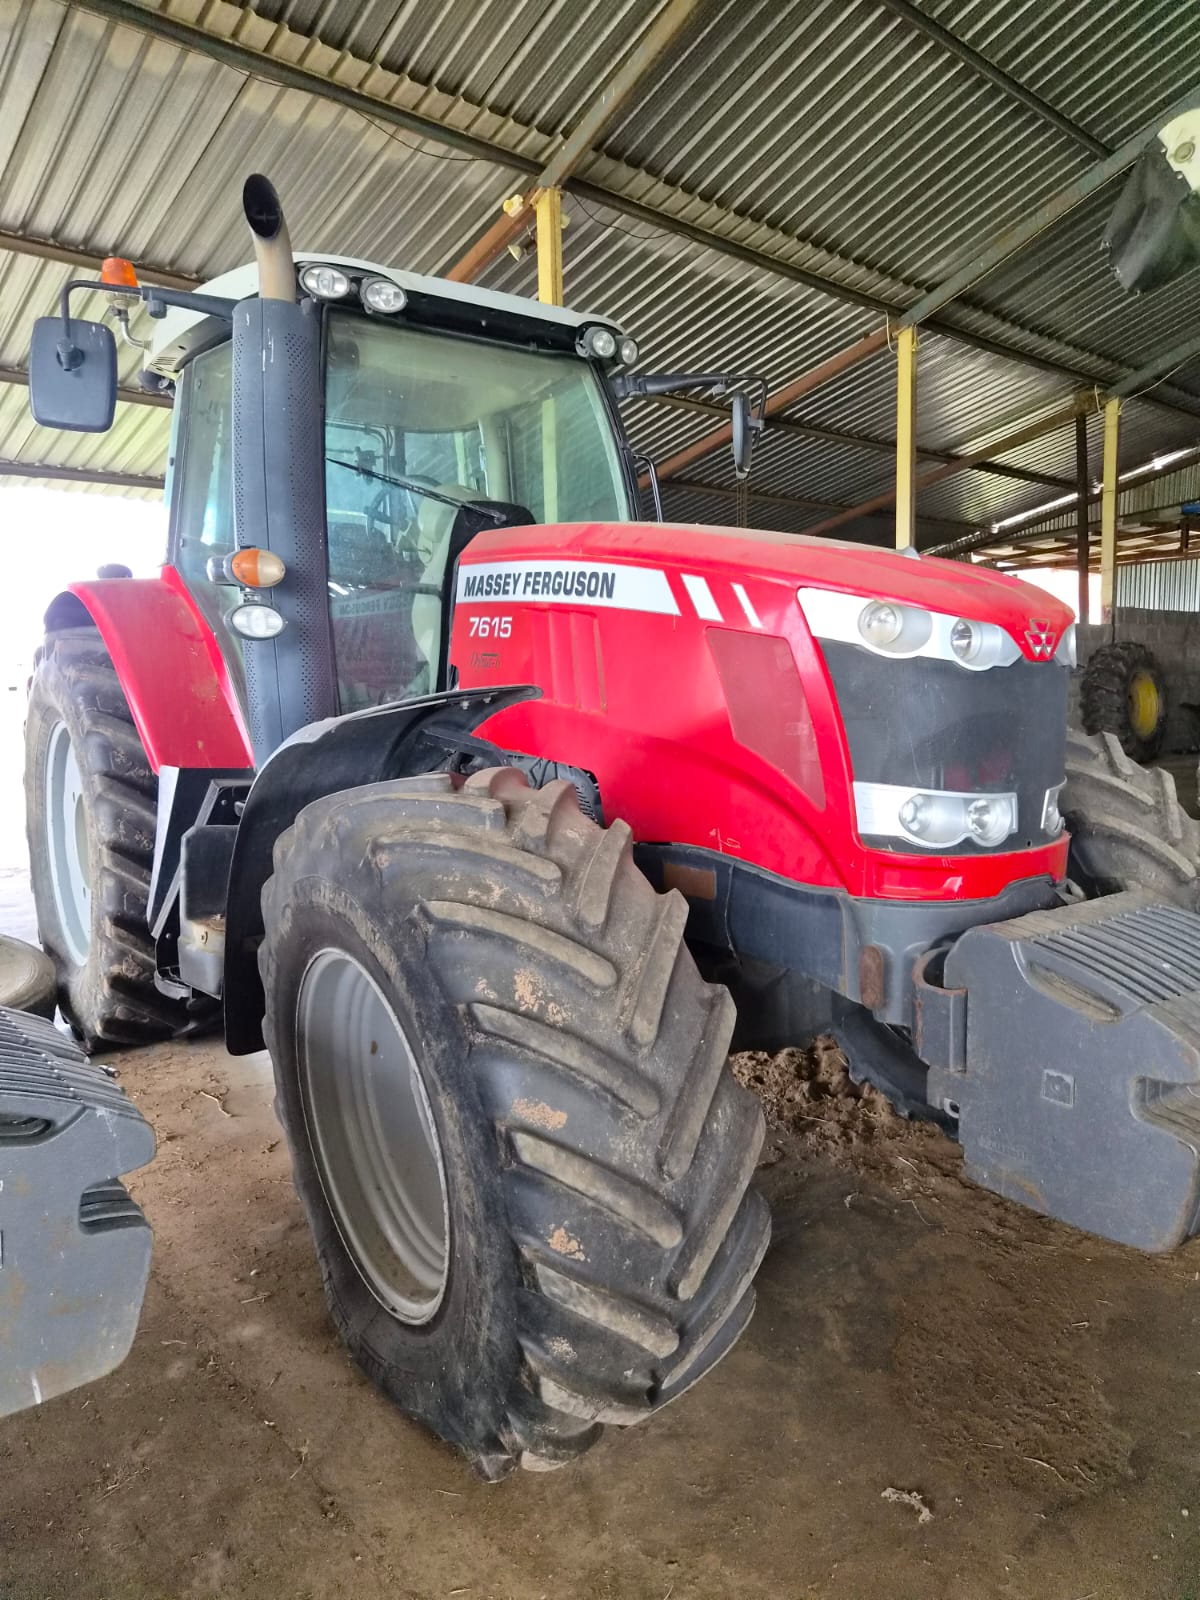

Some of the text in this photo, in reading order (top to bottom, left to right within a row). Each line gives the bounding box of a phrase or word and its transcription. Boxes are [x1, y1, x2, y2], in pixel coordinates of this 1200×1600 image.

[464, 571, 616, 599] MASSEY FERGUSON
[469, 616, 513, 638] 7615
